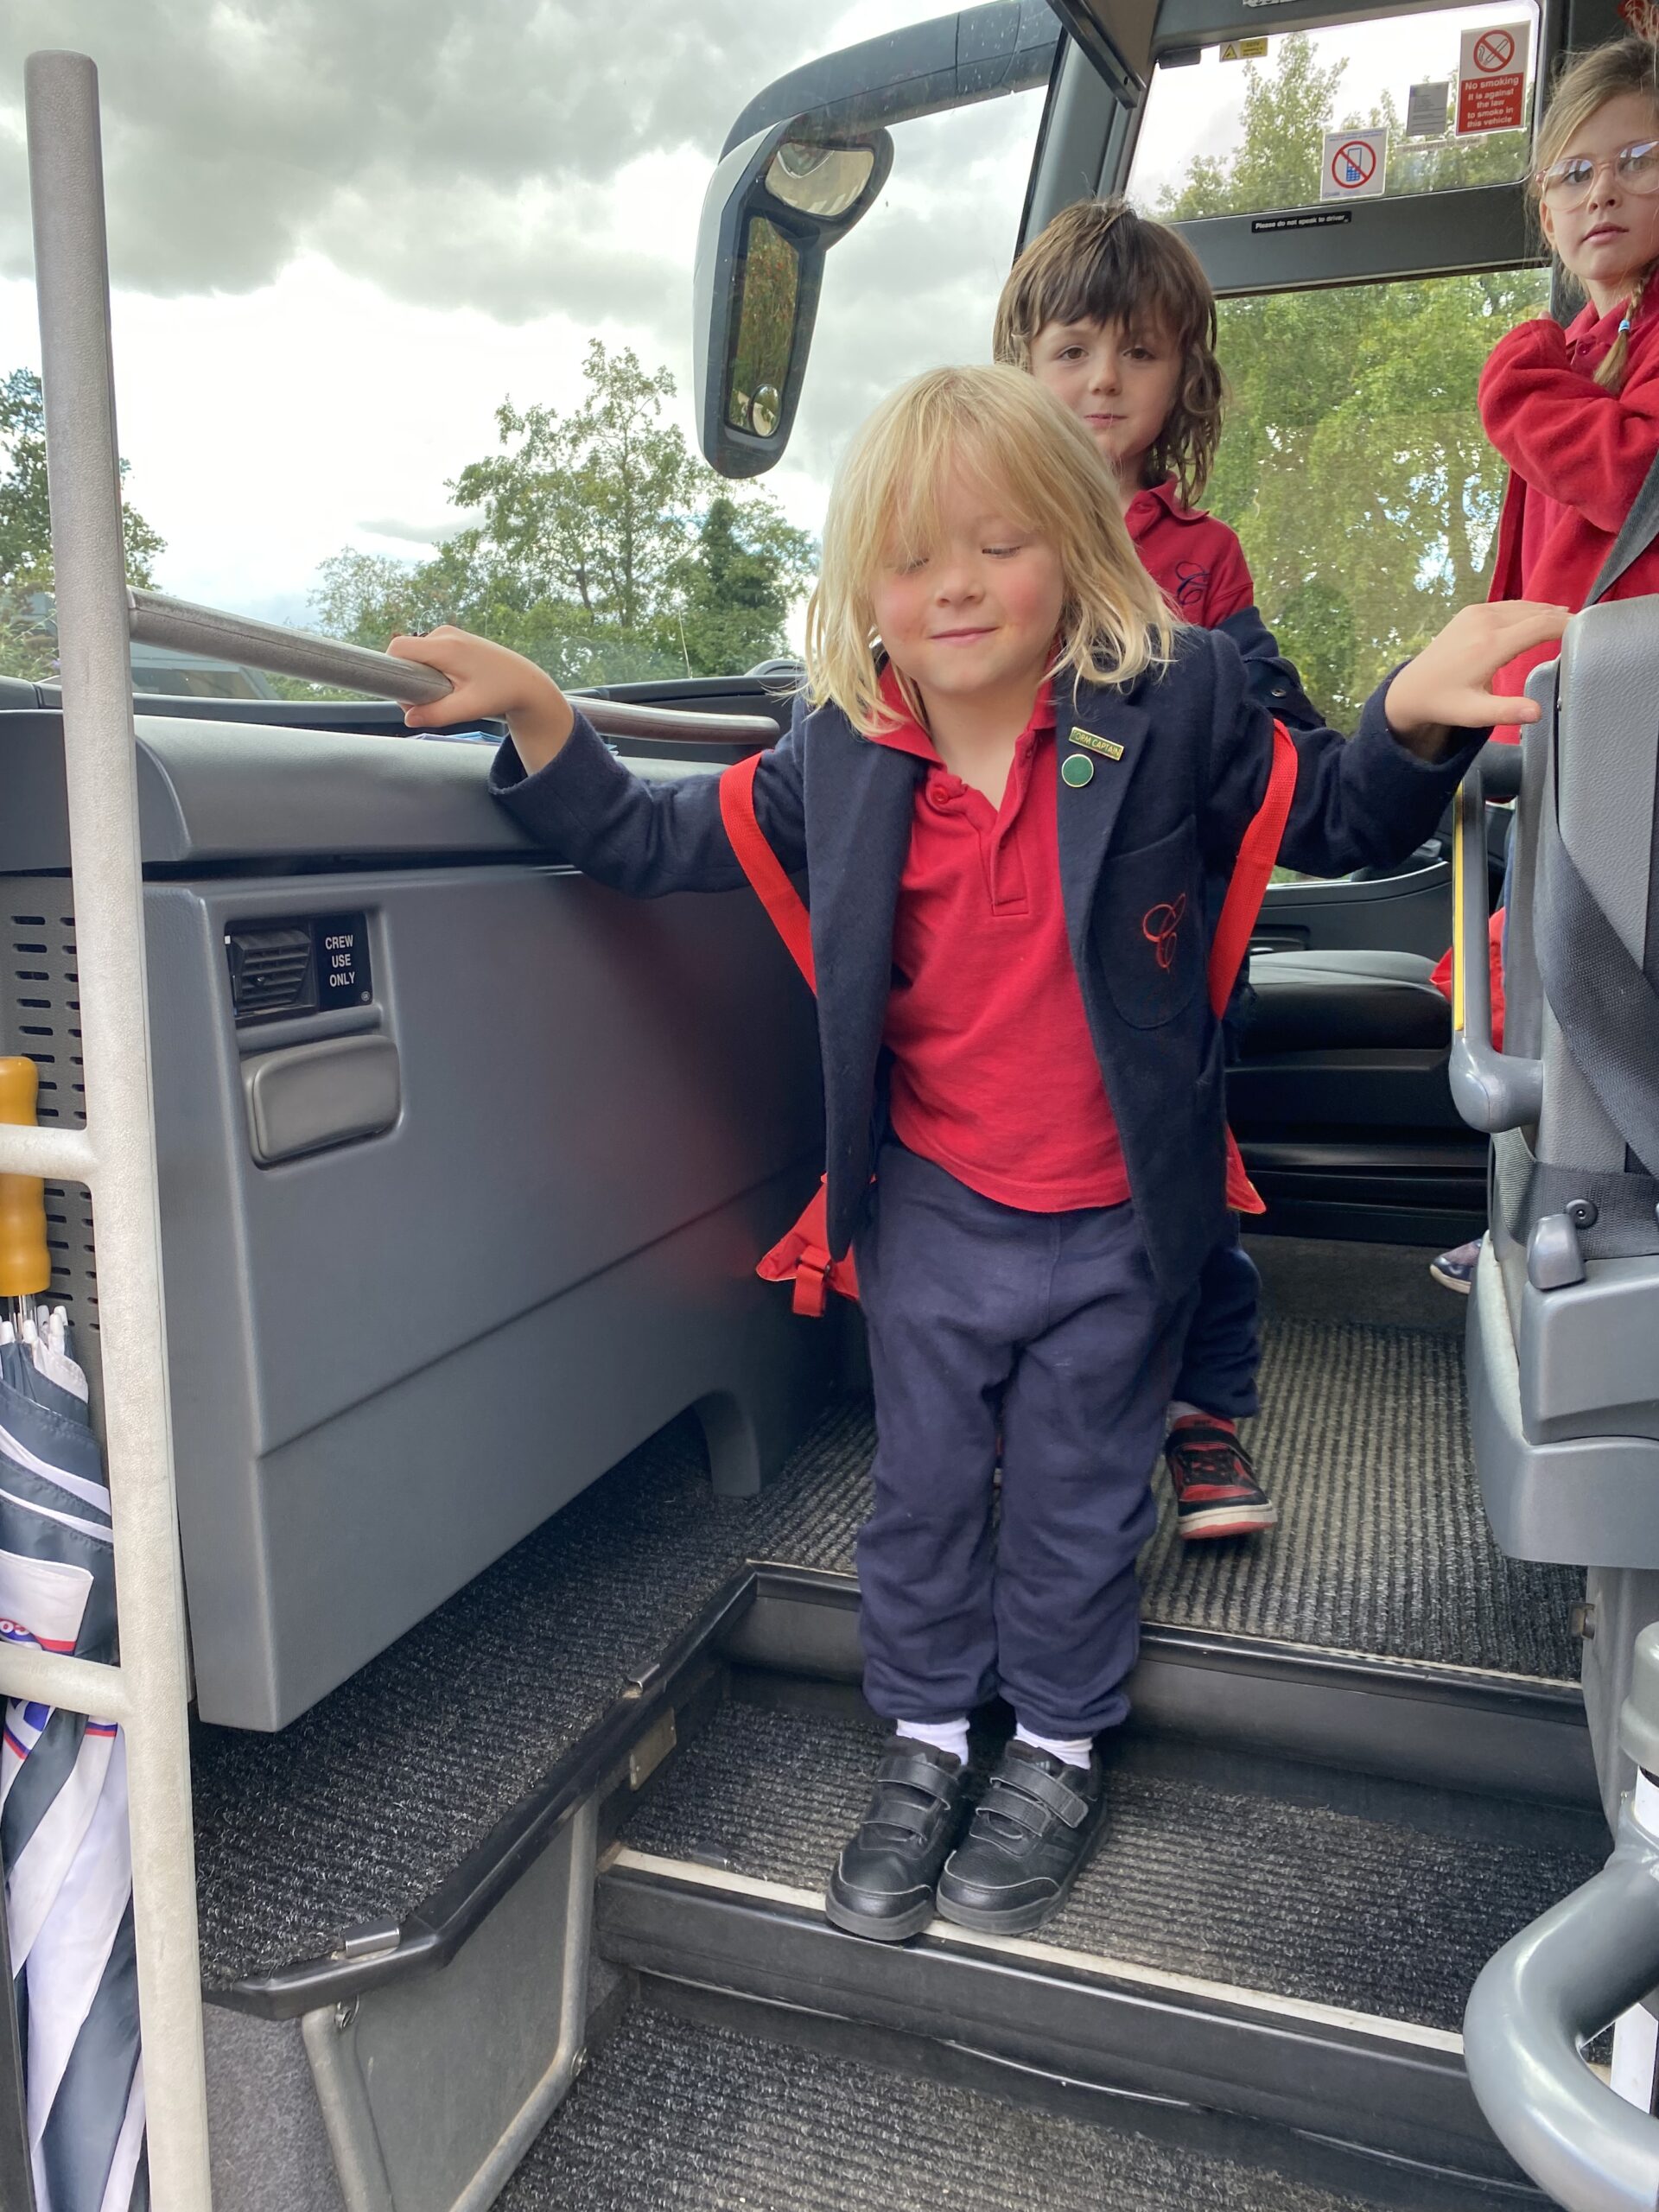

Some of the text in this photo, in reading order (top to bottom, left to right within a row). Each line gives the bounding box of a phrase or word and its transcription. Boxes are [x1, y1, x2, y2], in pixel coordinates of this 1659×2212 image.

[1480, 77, 1519, 88] smoking
[1484, 88, 1514, 99] against
[1478, 108, 1503, 118] smoke
[1484, 116, 1512, 125] vehicle
[1071, 730, 1122, 757] FORM CAPTAIN
[325, 935, 353, 950] CREW
[332, 954, 351, 968] USE
[329, 971, 355, 987] ONLY
